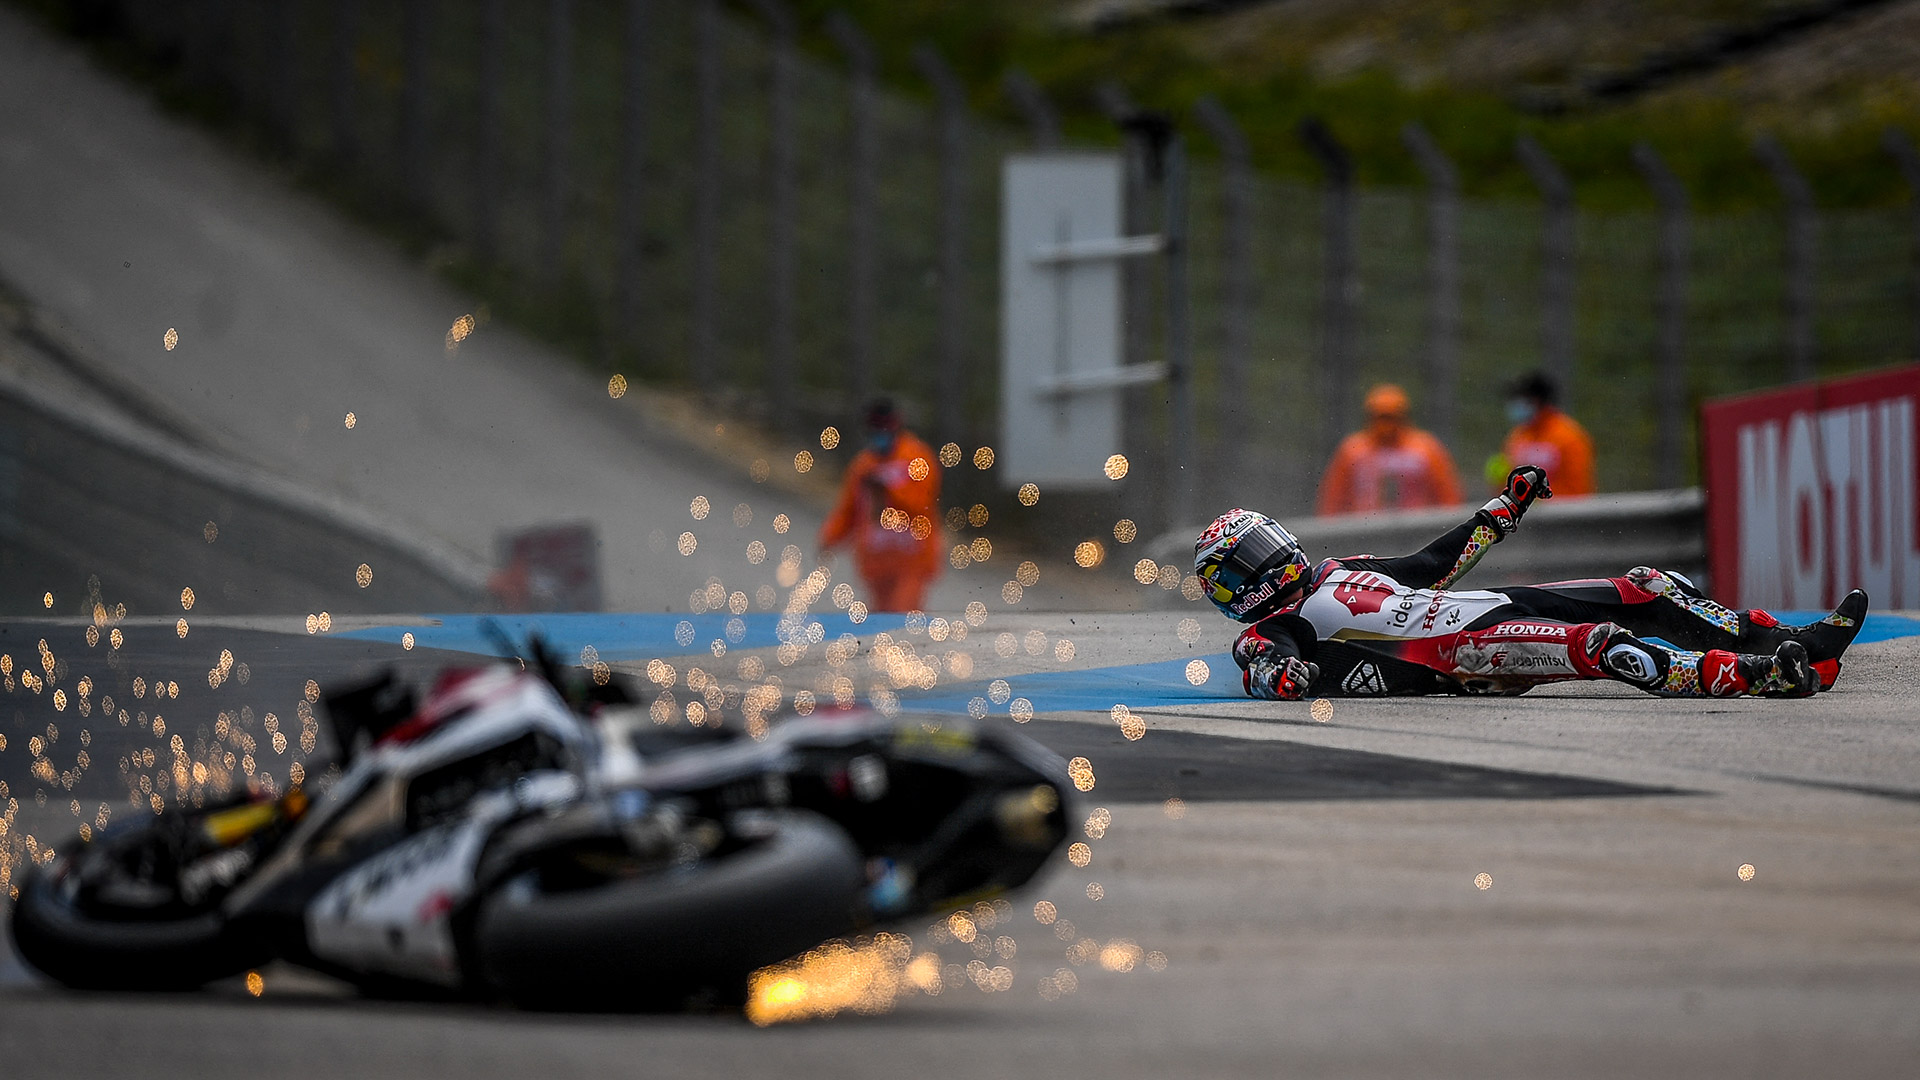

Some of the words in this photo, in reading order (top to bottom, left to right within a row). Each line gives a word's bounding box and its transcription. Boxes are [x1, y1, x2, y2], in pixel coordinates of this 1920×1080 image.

[1738, 396, 1920, 610] MOTUL
[1494, 624, 1567, 637] HONDA
[1512, 653, 1567, 668] idemitsu
